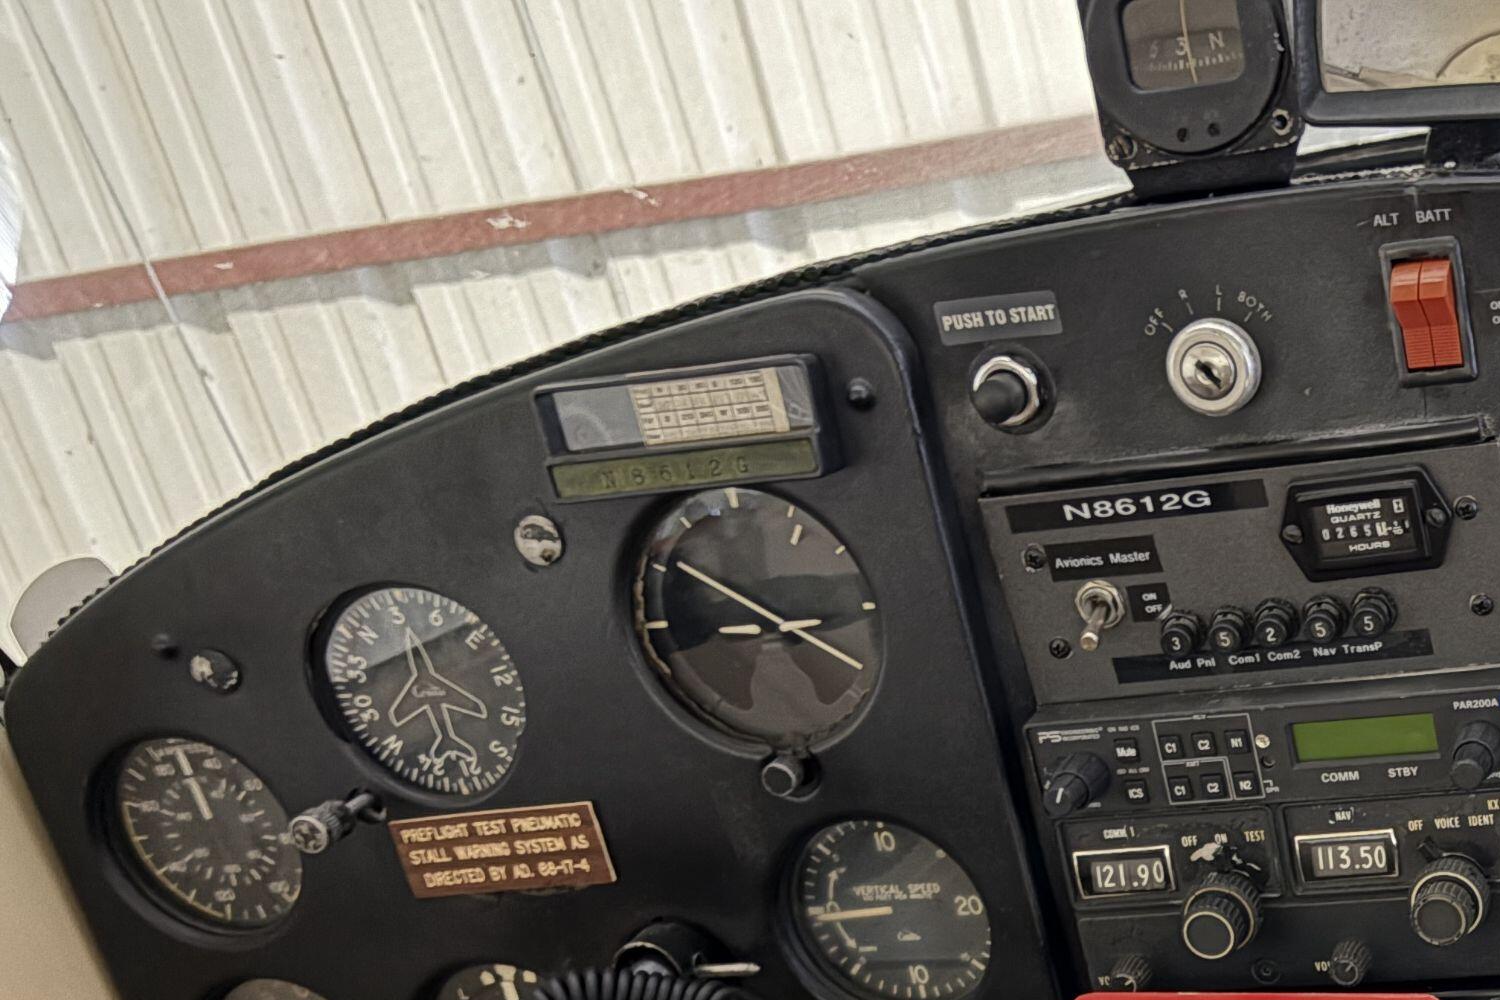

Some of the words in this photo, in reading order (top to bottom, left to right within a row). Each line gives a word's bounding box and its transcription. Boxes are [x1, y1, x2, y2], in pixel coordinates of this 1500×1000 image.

[1373, 212, 1400, 227] ALT
[1415, 208, 1452, 224] BATT
[1237, 290, 1273, 322] BOTH
[942, 309, 984, 332] PUSH
[984, 309, 1007, 327] TO
[1010, 303, 1056, 324] START
[1144, 306, 1165, 337] OFF
[1063, 490, 1212, 522] N8612G
[1326, 499, 1381, 515] Honeywell
[1330, 510, 1382, 524] QUARTZ
[1348, 540, 1391, 552] HOURS
[1055, 554, 1103, 569] Avionics
[1109, 551, 1151, 565] Master
[1142, 592, 1157, 601] ON
[1145, 603, 1163, 614] OFF
[1169, 659, 1191, 671] Aud
[1196, 656, 1216, 668] Pnl
[1228, 653, 1261, 666] Com1
[1267, 649, 1300, 662] Com2
[1313, 645, 1337, 657] Nav
[1342, 641, 1383, 655] TransP
[1452, 698, 1500, 711] PAR200A
[1115, 745, 1137, 758] Mute
[1164, 742, 1177, 754] C1
[1197, 739, 1210, 751] C2
[1230, 737, 1243, 749] N1
[1320, 771, 1360, 783] COMM
[1387, 766, 1419, 779] STBY
[1128, 787, 1144, 800] ICS
[1174, 784, 1187, 797] C1
[1206, 782, 1220, 794] C2
[1239, 779, 1253, 792] N2
[1334, 810, 1352, 822] NAV
[1434, 815, 1460, 829] VOICE
[1468, 813, 1494, 828] IDENT
[400, 822, 470, 844] PREFLIGHT
[471, 818, 507, 837] TEST
[509, 813, 582, 834] PNEUMATIC
[1407, 819, 1424, 832] OFF
[873, 830, 896, 852] 10
[1181, 835, 1198, 848] OFF
[1214, 833, 1228, 845] ON
[1244, 829, 1266, 842] TEST
[408, 849, 453, 867] STALL
[451, 841, 511, 861] WARNING
[514, 836, 568, 855] SYSTEM
[569, 834, 590, 850] AS
[1317, 845, 1388, 870] 113.50
[422, 867, 486, 889] DIRECTED
[488, 865, 508, 881] BY
[1096, 860, 1165, 889] 121.90
[852, 885, 902, 897] VERTICAL
[907, 882, 941, 894] SPEED
[953, 895, 984, 916] 20
[908, 964, 930, 985] 10
